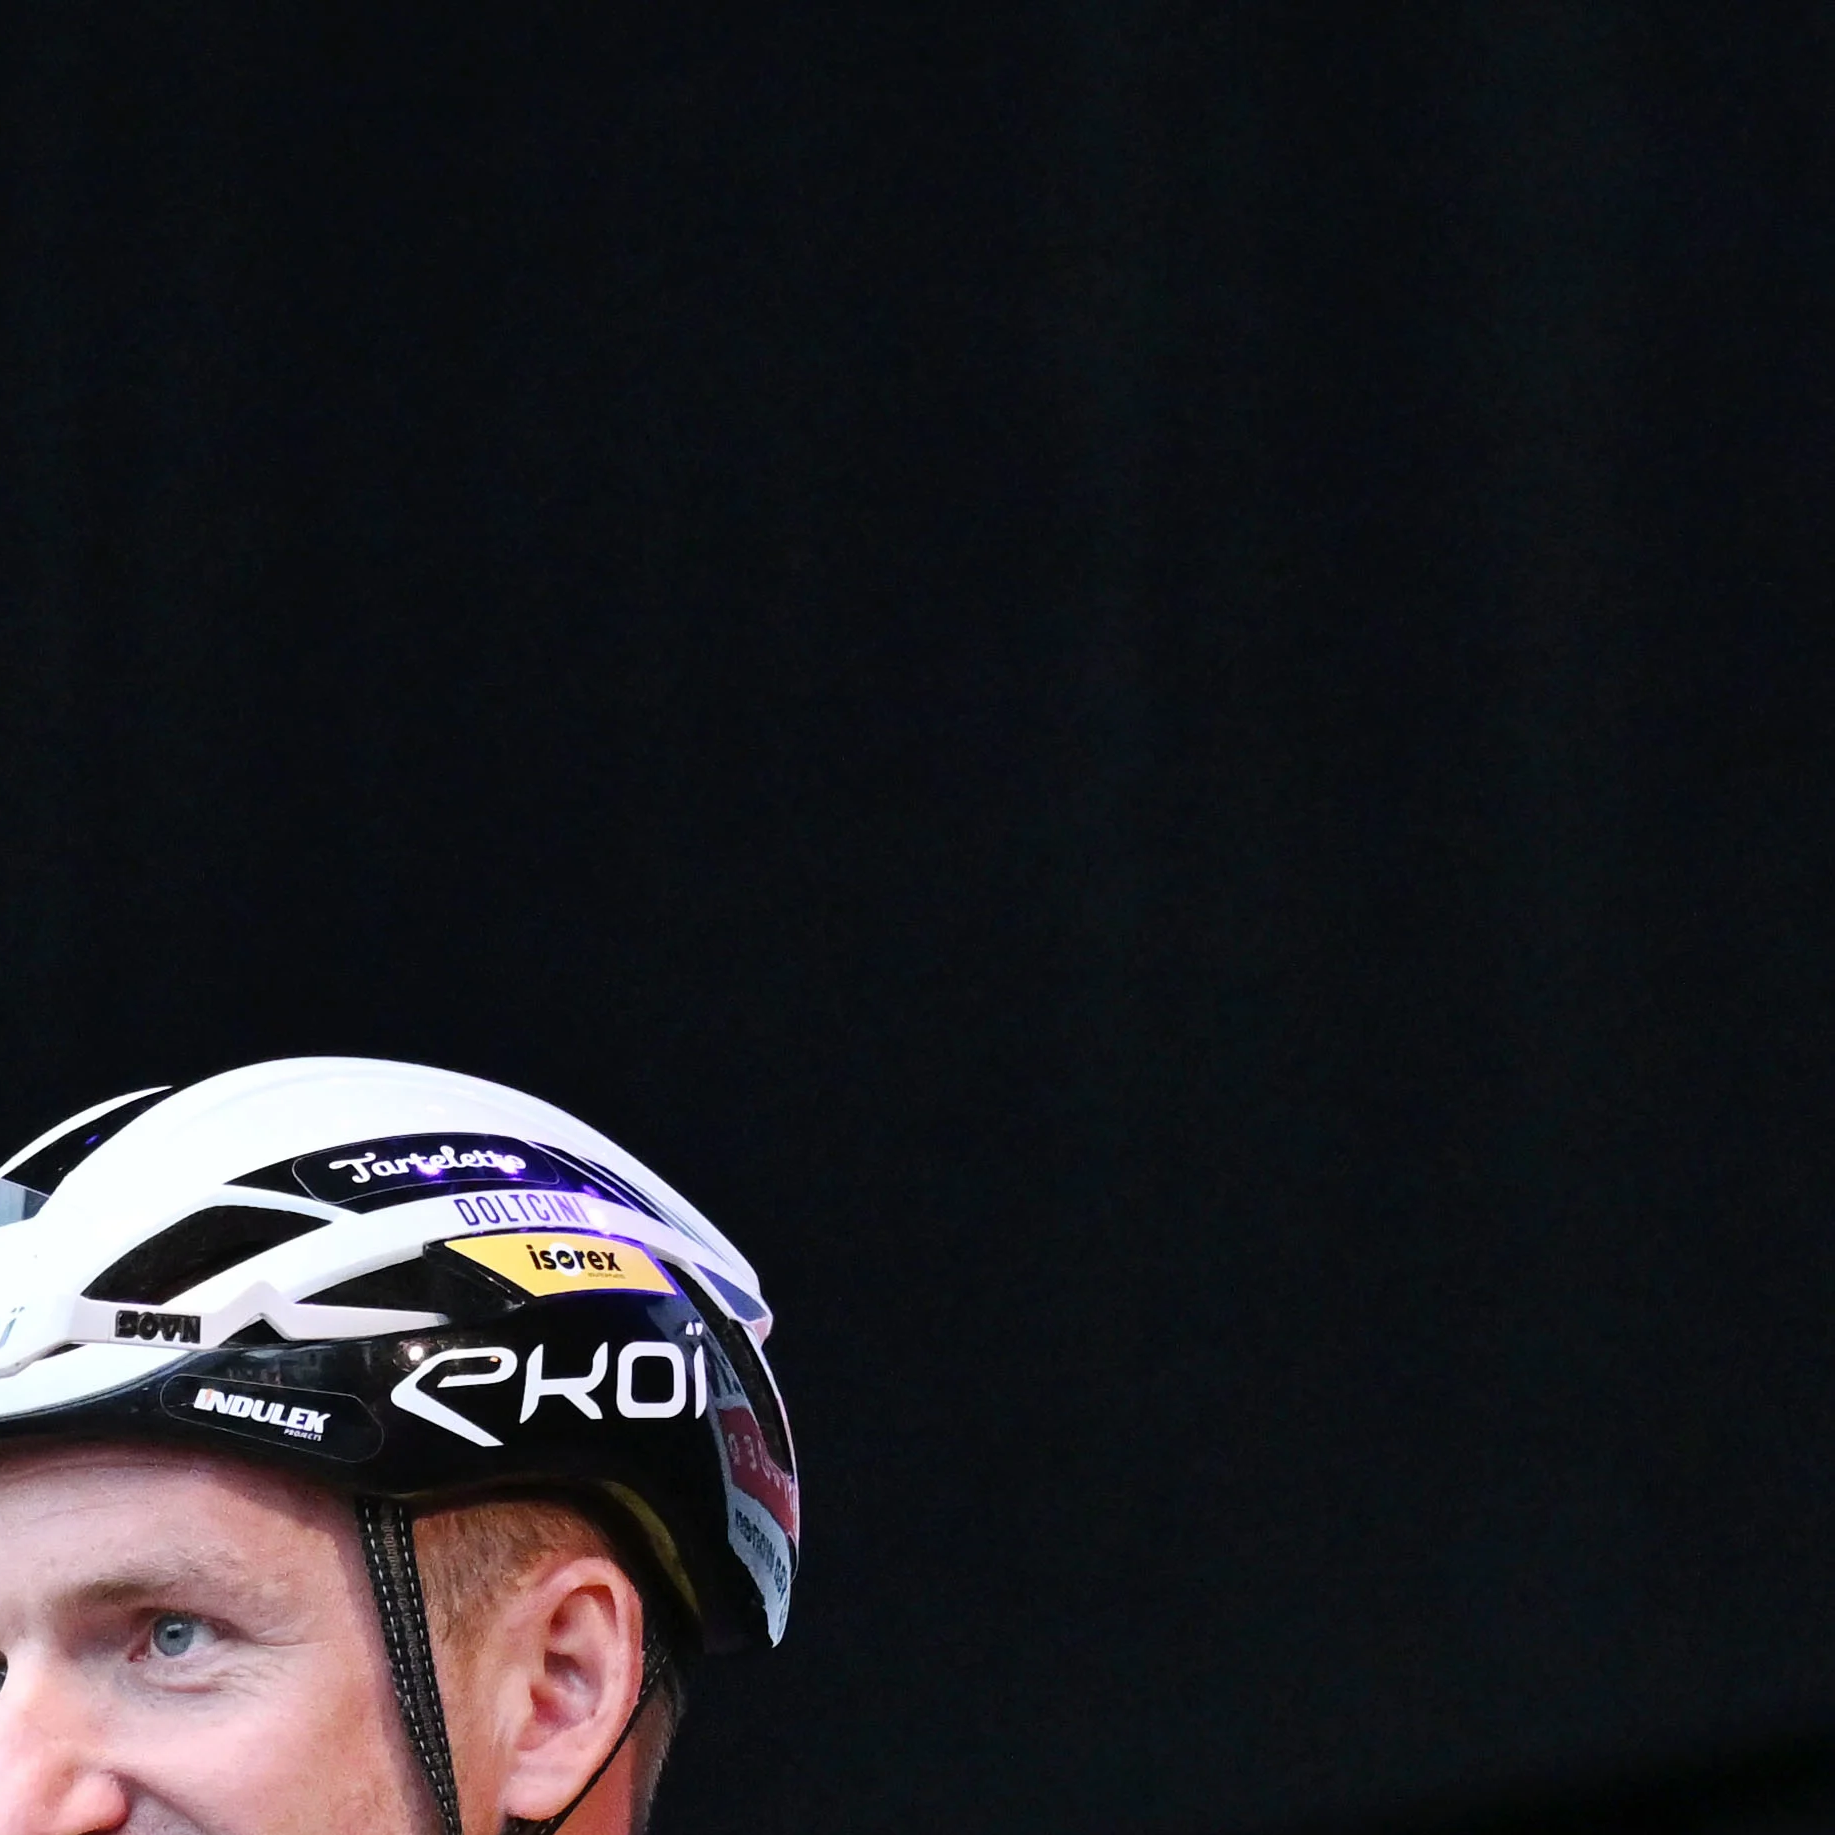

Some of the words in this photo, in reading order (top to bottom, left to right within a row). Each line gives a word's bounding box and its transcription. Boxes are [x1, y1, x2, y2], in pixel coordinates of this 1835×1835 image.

[329, 1145, 527, 1184] Tarteletto
[453, 1193, 590, 1226] DOLTCINI
[526, 1244, 622, 1272] isorex
[193, 1388, 331, 1433] INDULEK
